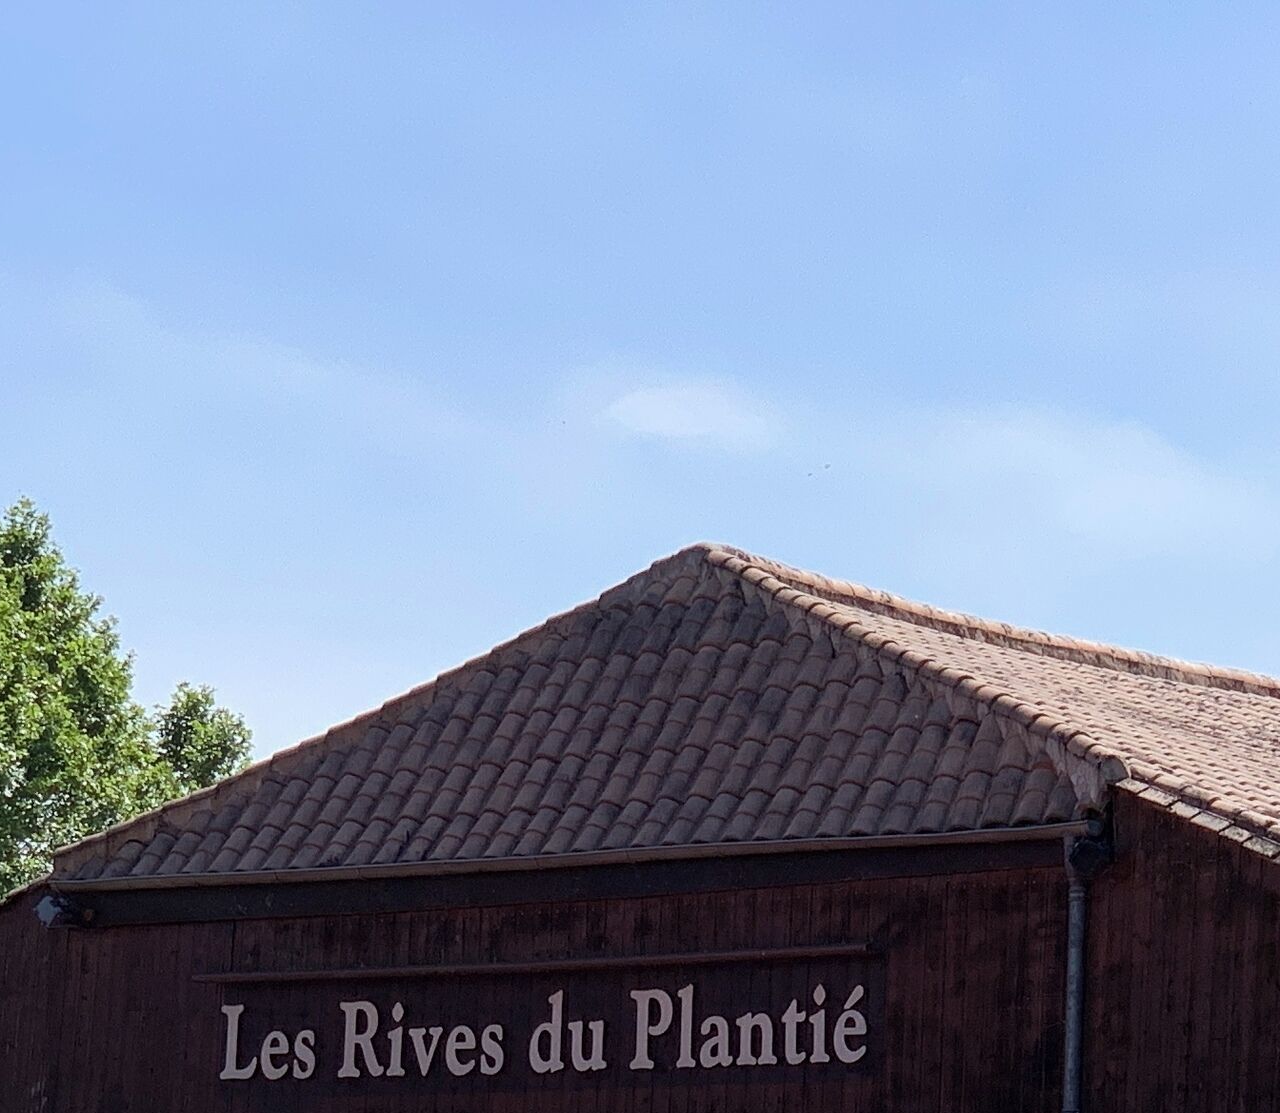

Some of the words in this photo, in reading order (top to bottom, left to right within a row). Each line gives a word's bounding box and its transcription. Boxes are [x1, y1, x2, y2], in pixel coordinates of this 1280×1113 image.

[219, 1004, 316, 1080] Les
[337, 1000, 504, 1078] Rives
[528, 989, 607, 1074] du
[629, 983, 867, 1070] Plantié
